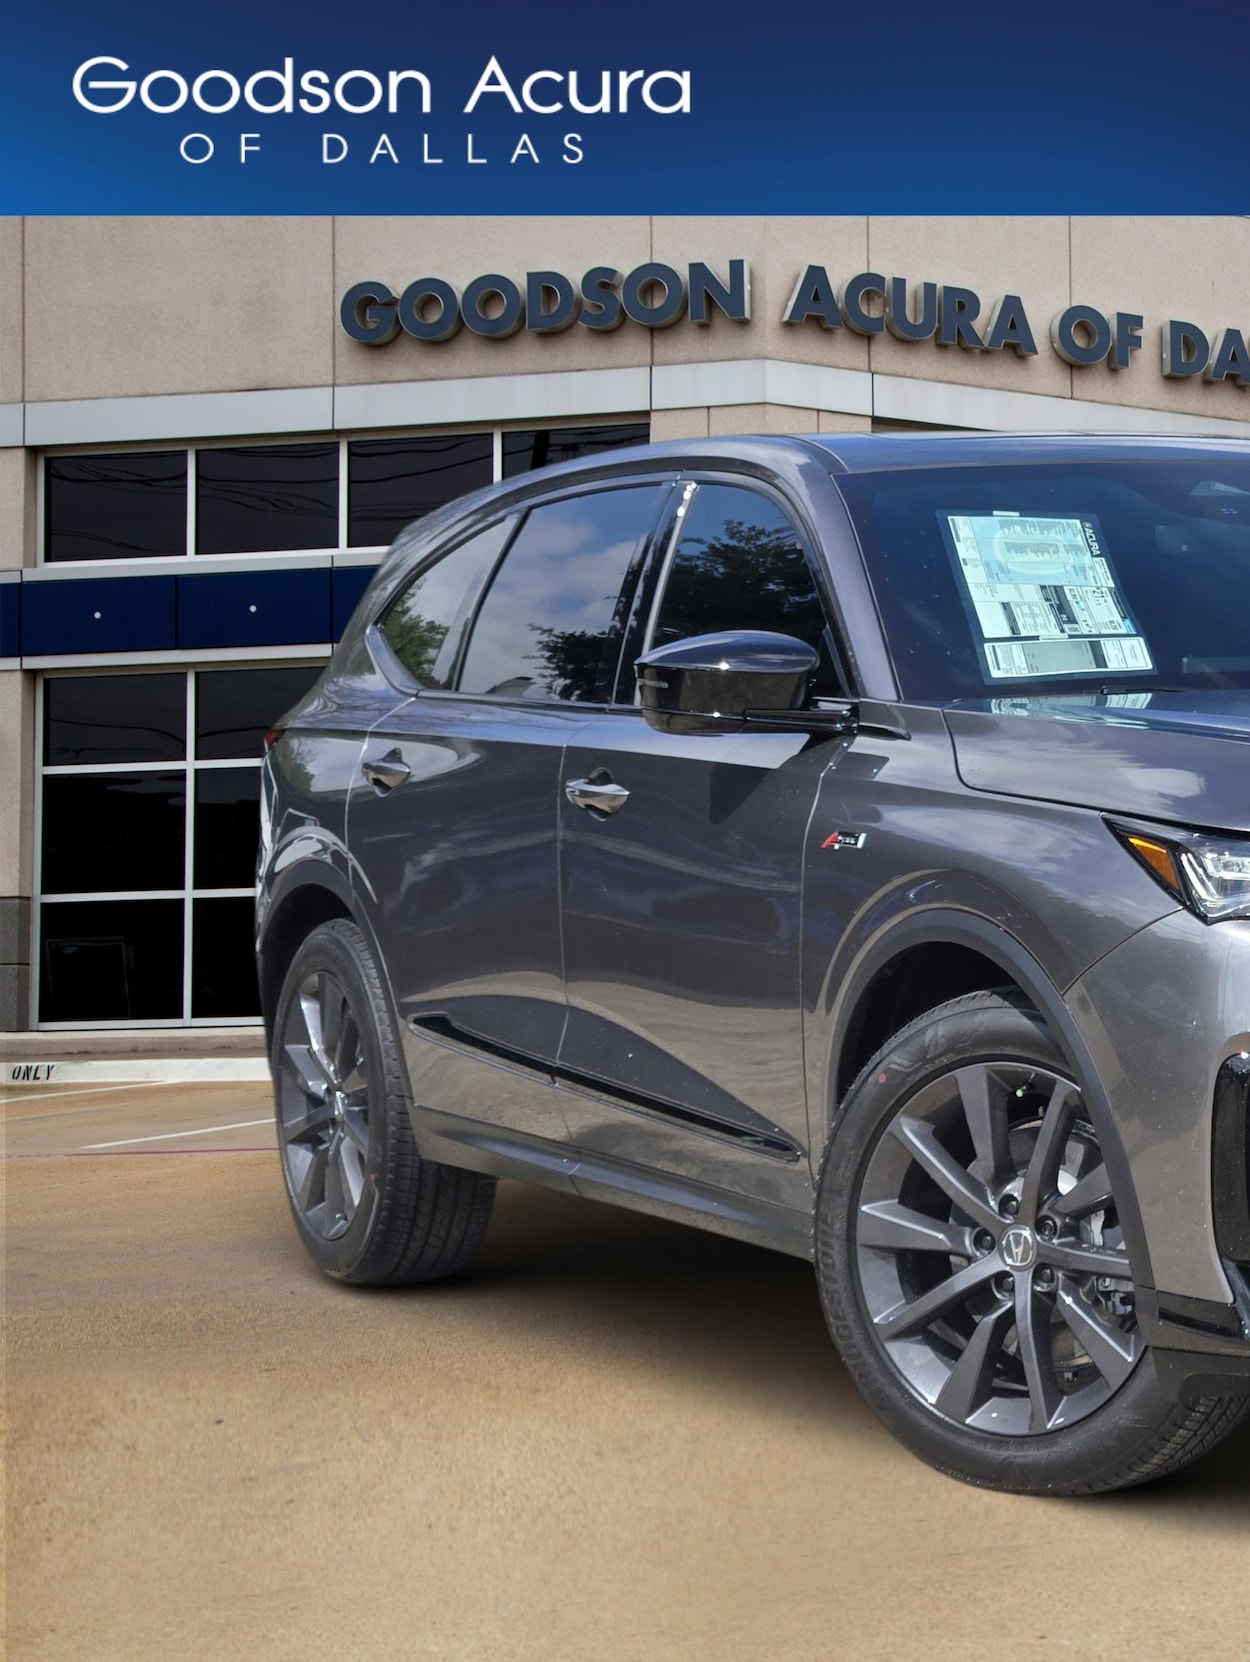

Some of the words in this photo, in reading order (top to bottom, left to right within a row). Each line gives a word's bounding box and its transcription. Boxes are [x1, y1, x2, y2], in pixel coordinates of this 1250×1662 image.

[340, 258, 751, 346] GOODSON
[782, 264, 1038, 357] ACURA
[1051, 305, 1144, 370] OF
[1084, 527, 1101, 556] ACURA
[12, 1064, 55, 1081] ONLY
